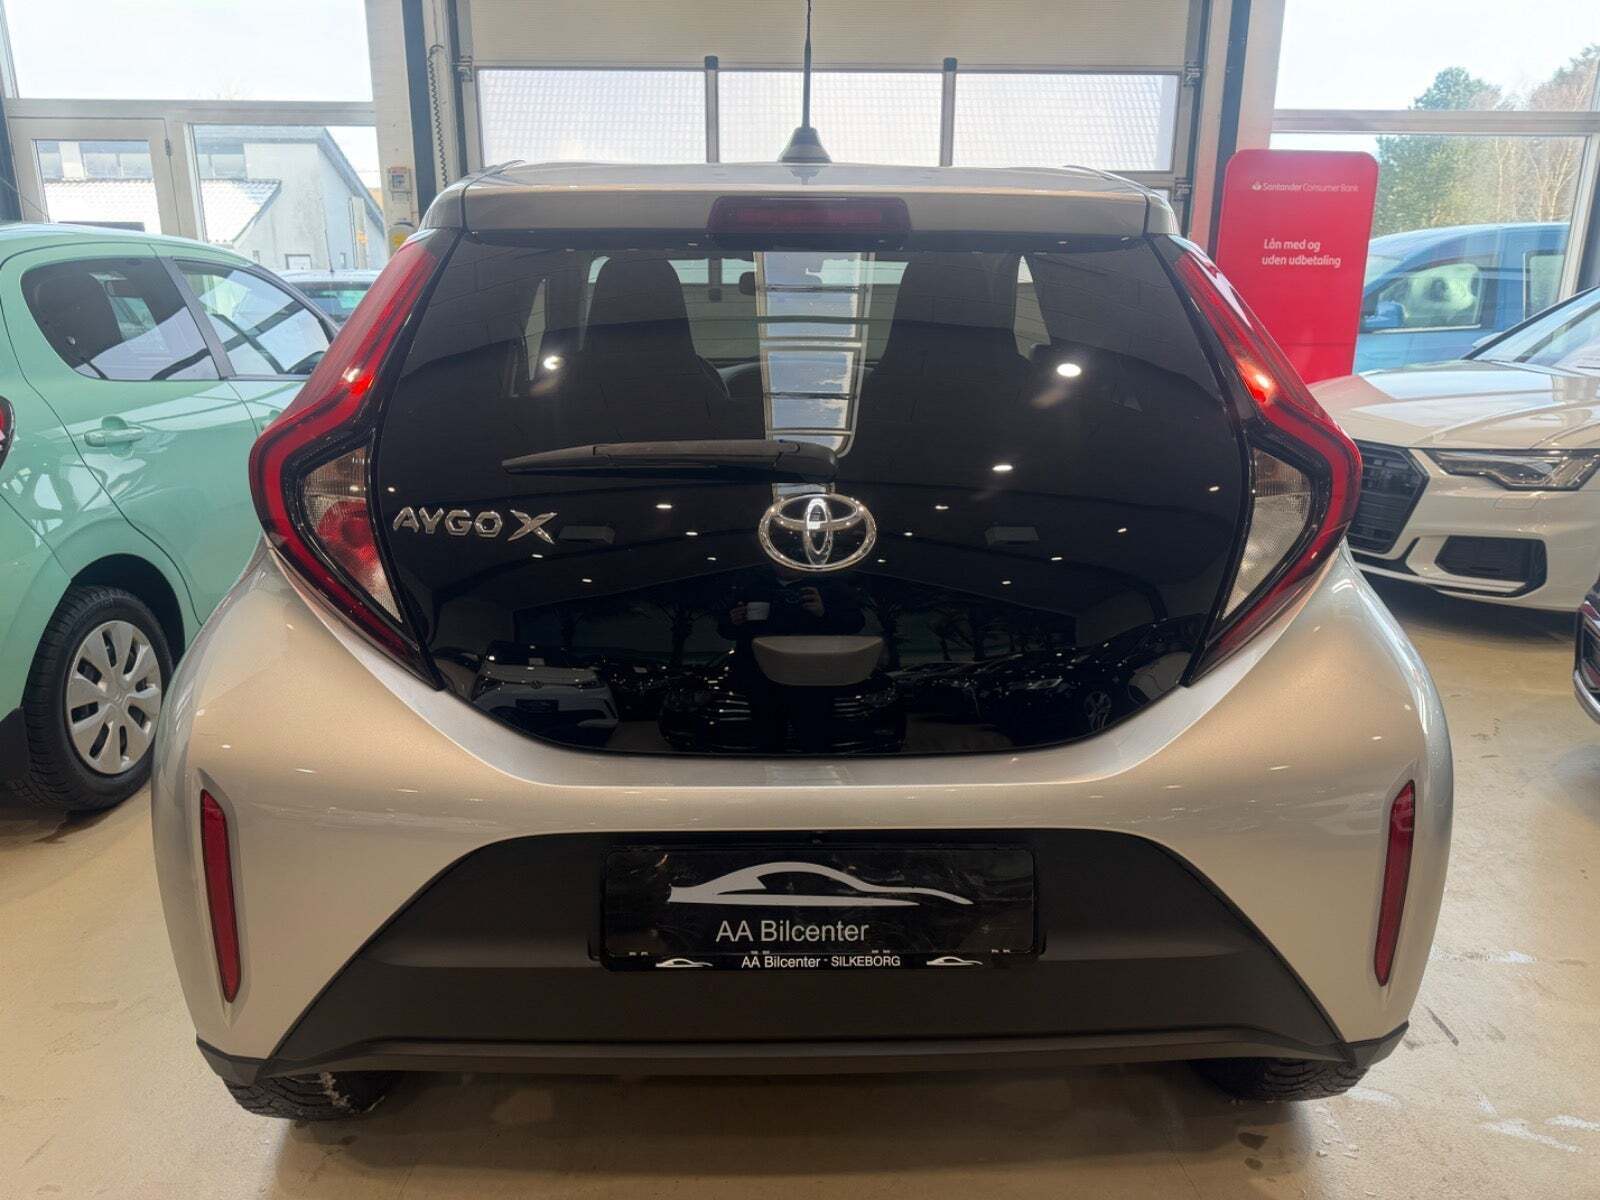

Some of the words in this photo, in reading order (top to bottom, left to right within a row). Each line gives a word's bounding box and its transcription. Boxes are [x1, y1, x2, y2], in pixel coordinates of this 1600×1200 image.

[1262, 182, 1301, 192] Santander
[1302, 183, 1340, 193] Consumer
[1341, 184, 1360, 193] Bank
[1264, 238, 1282, 250] Lån
[1283, 239, 1306, 250] med
[1307, 241, 1321, 253] og
[1262, 255, 1287, 266] uden
[1288, 255, 1341, 269] udbetaling
[392, 506, 503, 538] AYGO
[507, 509, 558, 545] X
[715, 920, 754, 943] AA
[760, 920, 870, 943] Bilcenter
[741, 956, 761, 969] AA
[764, 955, 821, 969] Bilcenter
[831, 955, 901, 967] SILKEBORG
